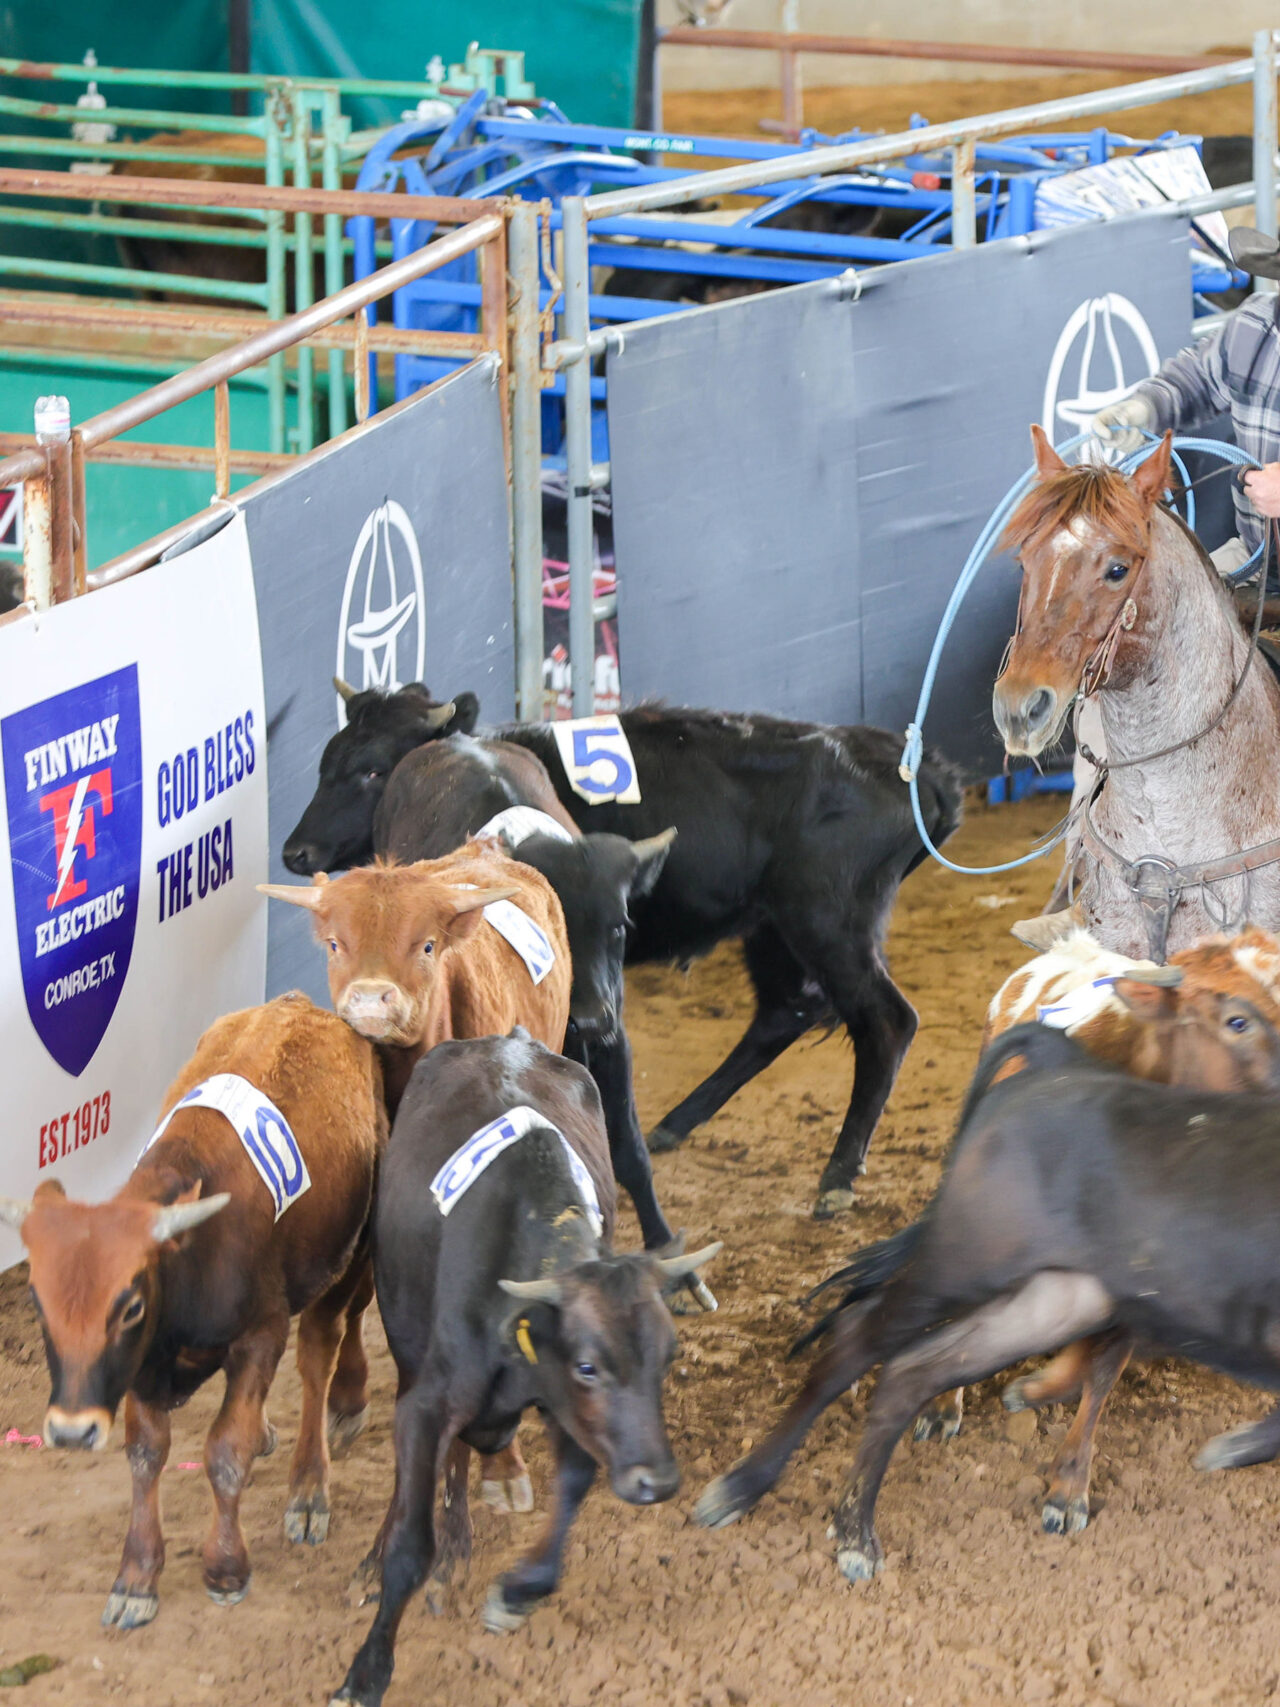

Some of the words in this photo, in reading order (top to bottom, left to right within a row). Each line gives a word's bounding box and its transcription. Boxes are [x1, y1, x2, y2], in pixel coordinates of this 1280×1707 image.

[24, 713, 119, 793] FINWAY
[157, 746, 199, 828] GOD
[205, 709, 255, 803] BLESS
[572, 727, 632, 794] 5
[157, 842, 193, 924] THE
[197, 817, 233, 900] USA
[35, 885, 124, 958] ELECTRIC
[44, 951, 115, 1010] CONROE,TX
[39, 1090, 111, 1169] EST.1973
[243, 1106, 303, 1213] 10
